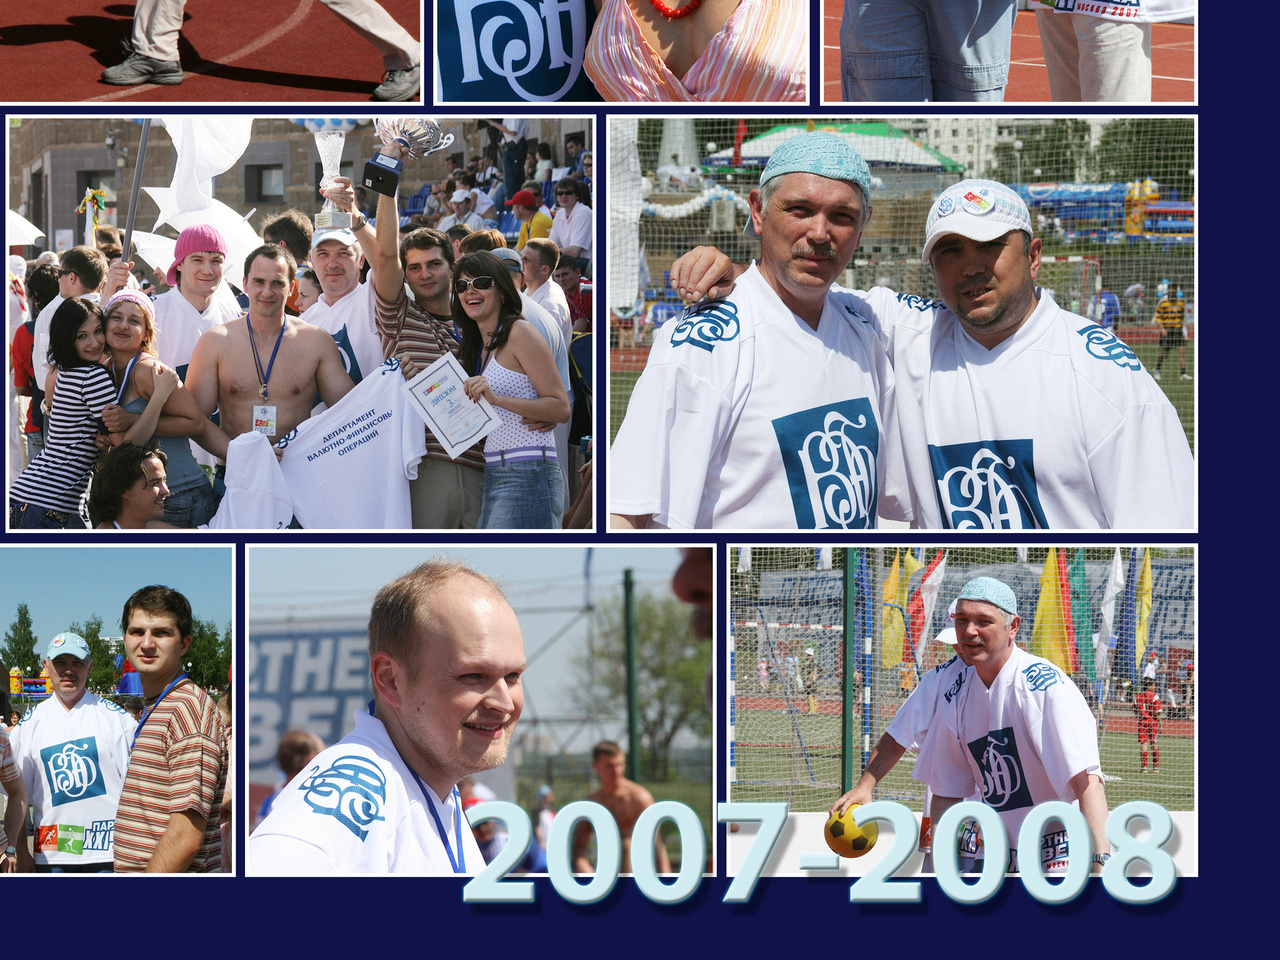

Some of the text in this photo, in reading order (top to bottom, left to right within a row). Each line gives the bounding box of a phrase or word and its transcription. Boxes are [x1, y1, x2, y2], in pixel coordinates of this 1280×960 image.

[1111, 6, 1138, 18] 2007
[323, 409, 376, 443] ДЕПАРТАМЕНТ
[338, 430, 379, 456] ОПЕРАЦИЙ
[83, 830, 109, 850] XXI
